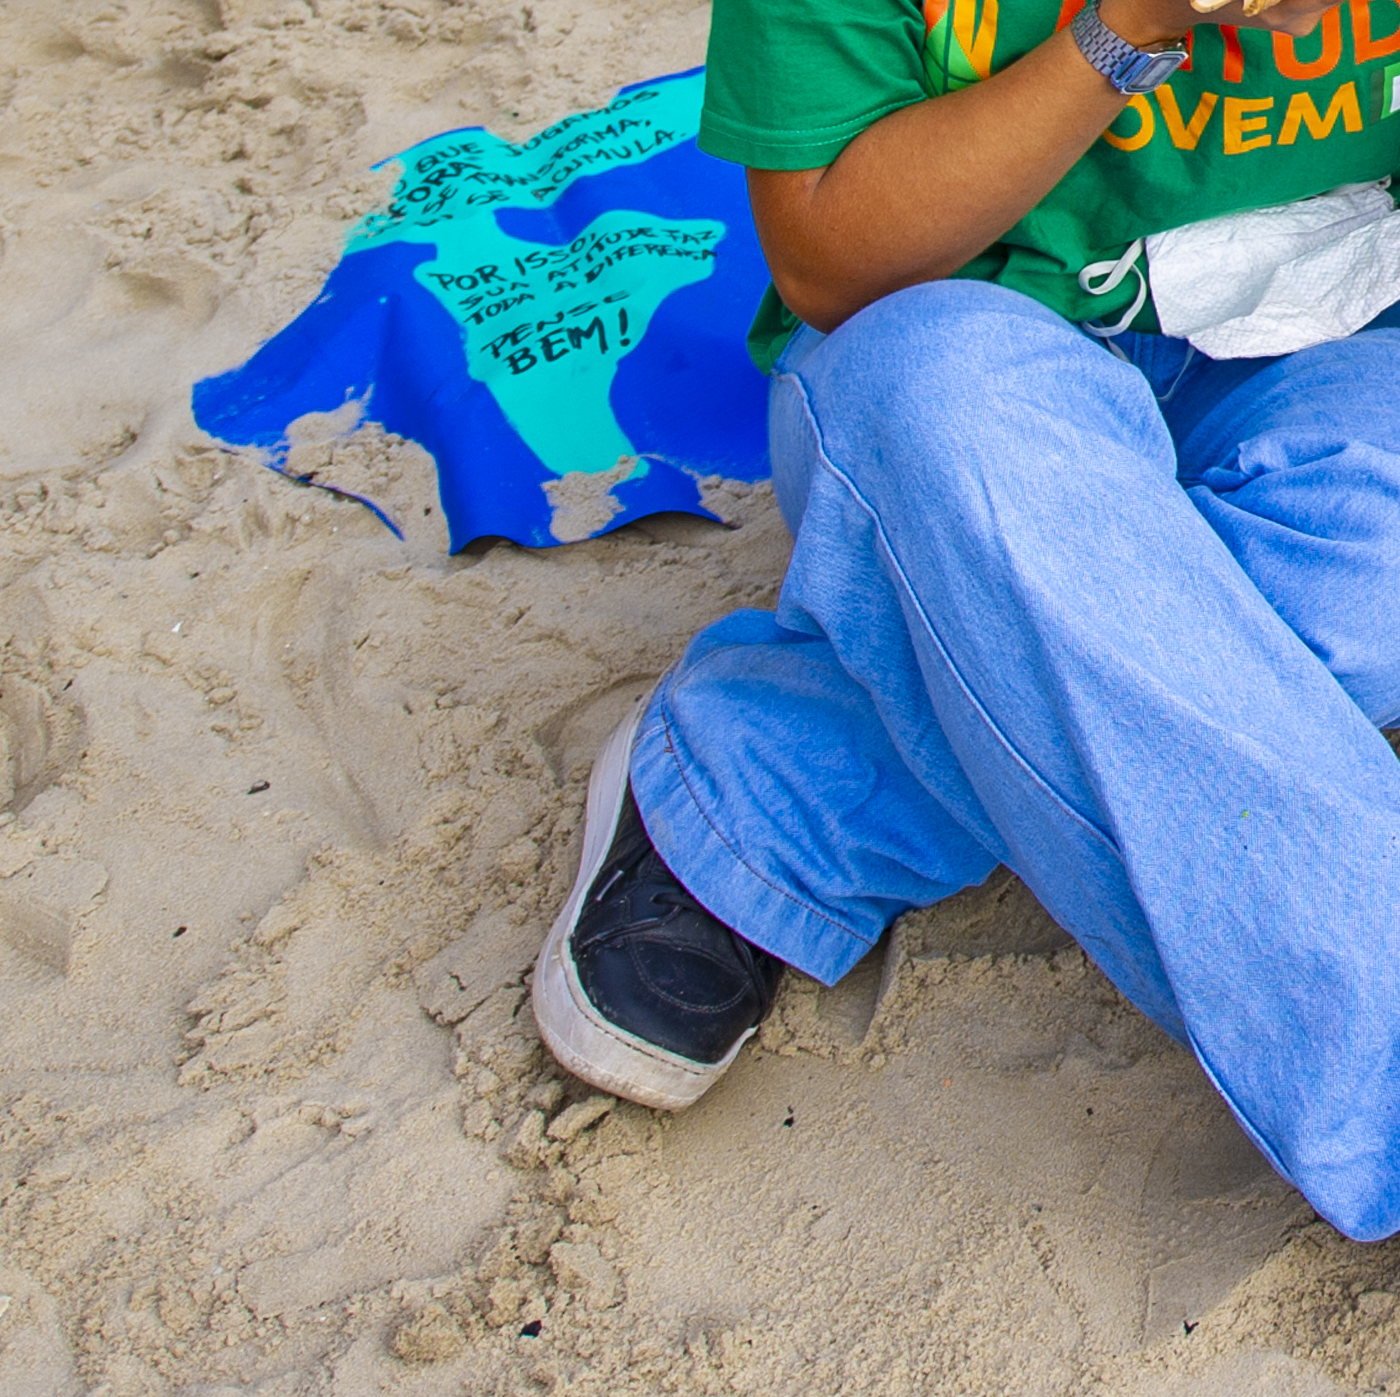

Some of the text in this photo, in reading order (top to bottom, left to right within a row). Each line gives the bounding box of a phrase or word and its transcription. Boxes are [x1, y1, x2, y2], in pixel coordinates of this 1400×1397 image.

[1102, 81, 1363, 155] OVEM
[426, 264, 508, 291] POR
[457, 227, 718, 312] SUA ATITUDE FAZ
[463, 293, 536, 326] TODA
[554, 280, 578, 293] A
[480, 290, 631, 359] PENSE
[502, 306, 632, 376] BEM!
